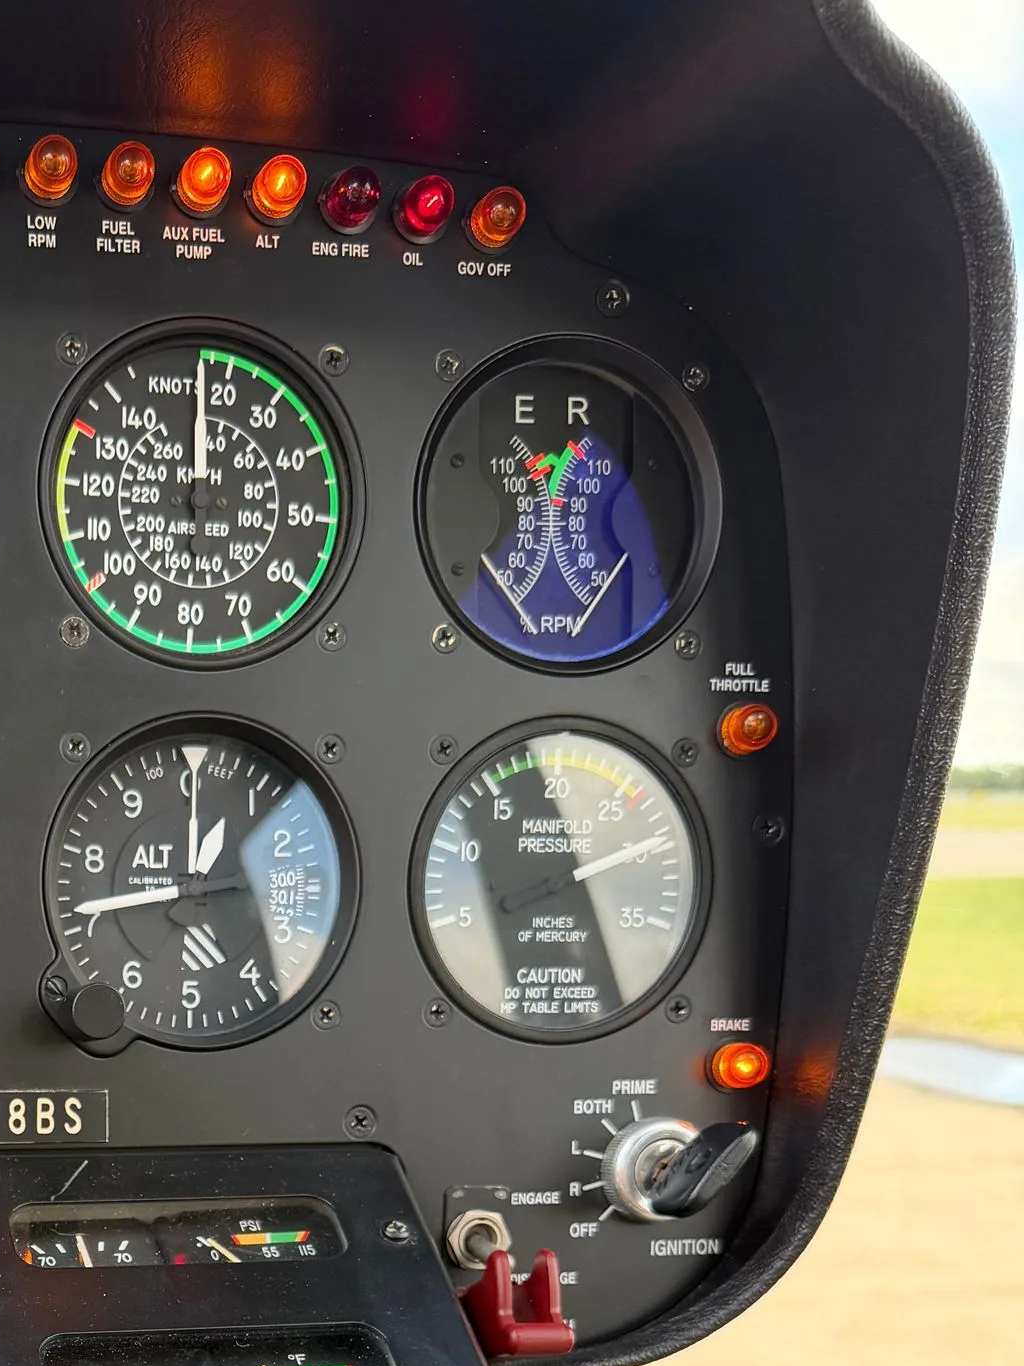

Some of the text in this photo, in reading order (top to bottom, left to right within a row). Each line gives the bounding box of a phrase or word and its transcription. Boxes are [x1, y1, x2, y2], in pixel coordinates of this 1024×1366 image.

[27, 214, 57, 231] LOW
[102, 220, 135, 236] FUEL
[28, 232, 57, 249] RPM
[163, 225, 225, 243] AUX FUEL
[255, 234, 280, 250] ALT
[96, 237, 141, 255] FILTER
[176, 243, 212, 260] PUMP
[312, 241, 370, 258] ENG FIRE
[402, 251, 423, 267] OIL
[457, 261, 512, 278] GOV OFF
[515, 395, 590, 425] E R
[82, 475, 115, 498] 120
[287, 503, 313, 527] 50
[177, 602, 204, 626] 80
[224, 594, 252, 617] 70
[725, 662, 755, 676] FULL
[709, 678, 771, 693] THROTTLE
[522, 819, 592, 835] MANIFOLD
[518, 837, 592, 854] PRESSURE
[132, 843, 174, 869] ALT
[532, 917, 574, 929] INCHES
[517, 931, 587, 943] OF MERCURY
[122, 960, 143, 989] 6
[516, 967, 582, 984] CAUTION
[180, 980, 202, 1009] 5
[504, 987, 595, 999] DO NOT EXCEED
[500, 1001, 598, 1014] MP TABLE LIMITS
[710, 1019, 751, 1032] BRAKE
[612, 1079, 658, 1095] PRIME
[573, 1099, 614, 1114] BOTH
[511, 1191, 561, 1206] ENGAGE
[569, 1222, 599, 1238] OFF
[650, 1238, 721, 1257] IGNITION
